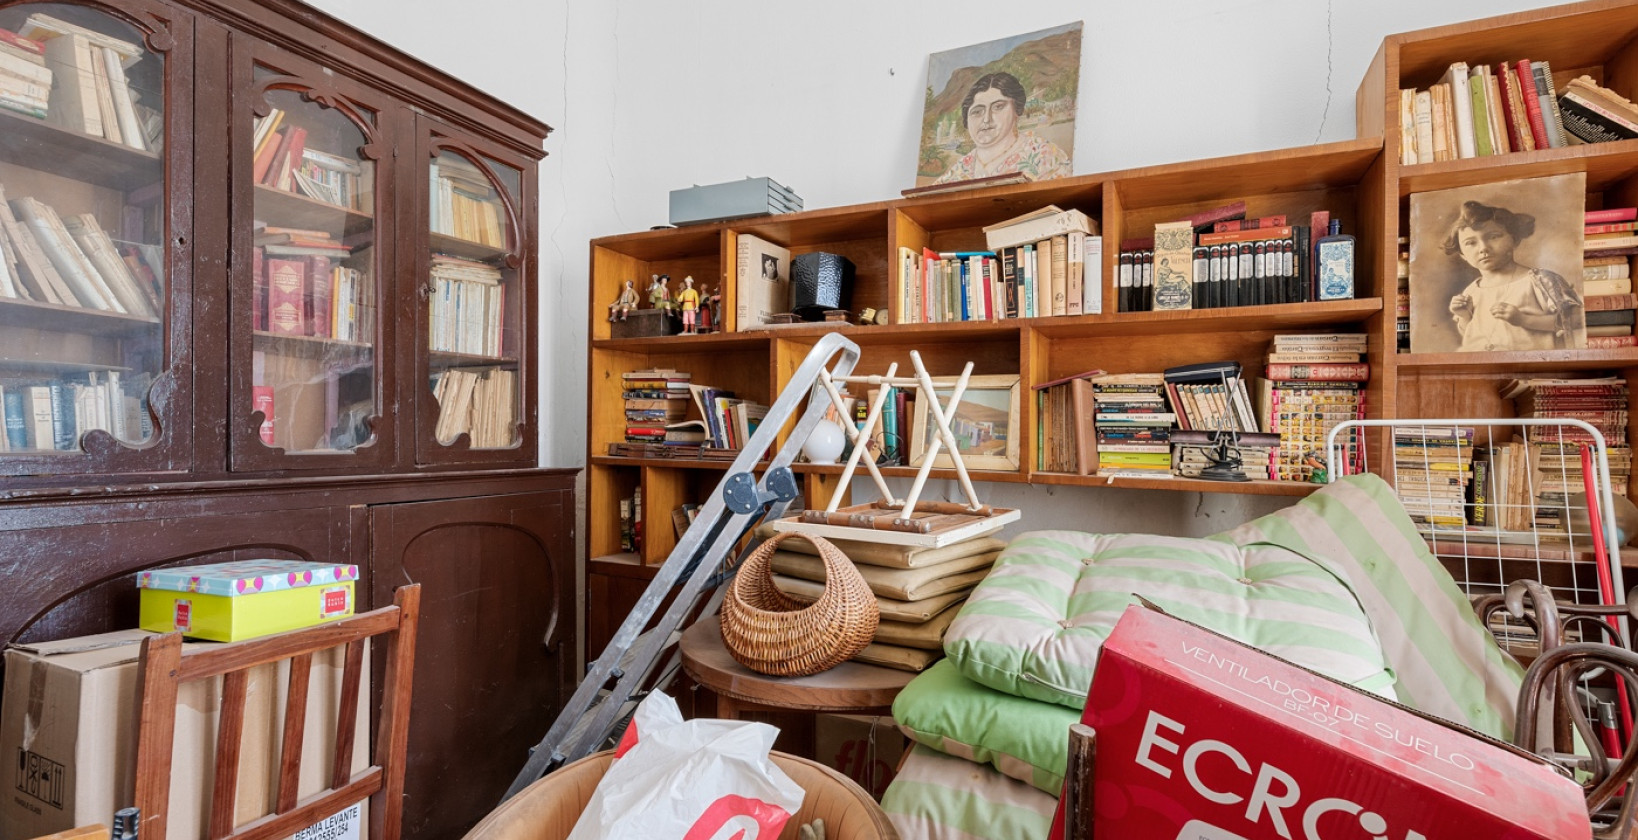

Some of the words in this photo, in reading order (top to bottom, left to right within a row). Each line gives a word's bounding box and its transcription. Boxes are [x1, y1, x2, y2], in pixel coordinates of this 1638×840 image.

[1182, 641, 1329, 712] VENTILADOR
[1334, 705, 1370, 731] DE
[1374, 722, 1474, 770] SUELO
[1284, 699, 1340, 726] BF-07
[325, 806, 358, 830] LEVANTE
